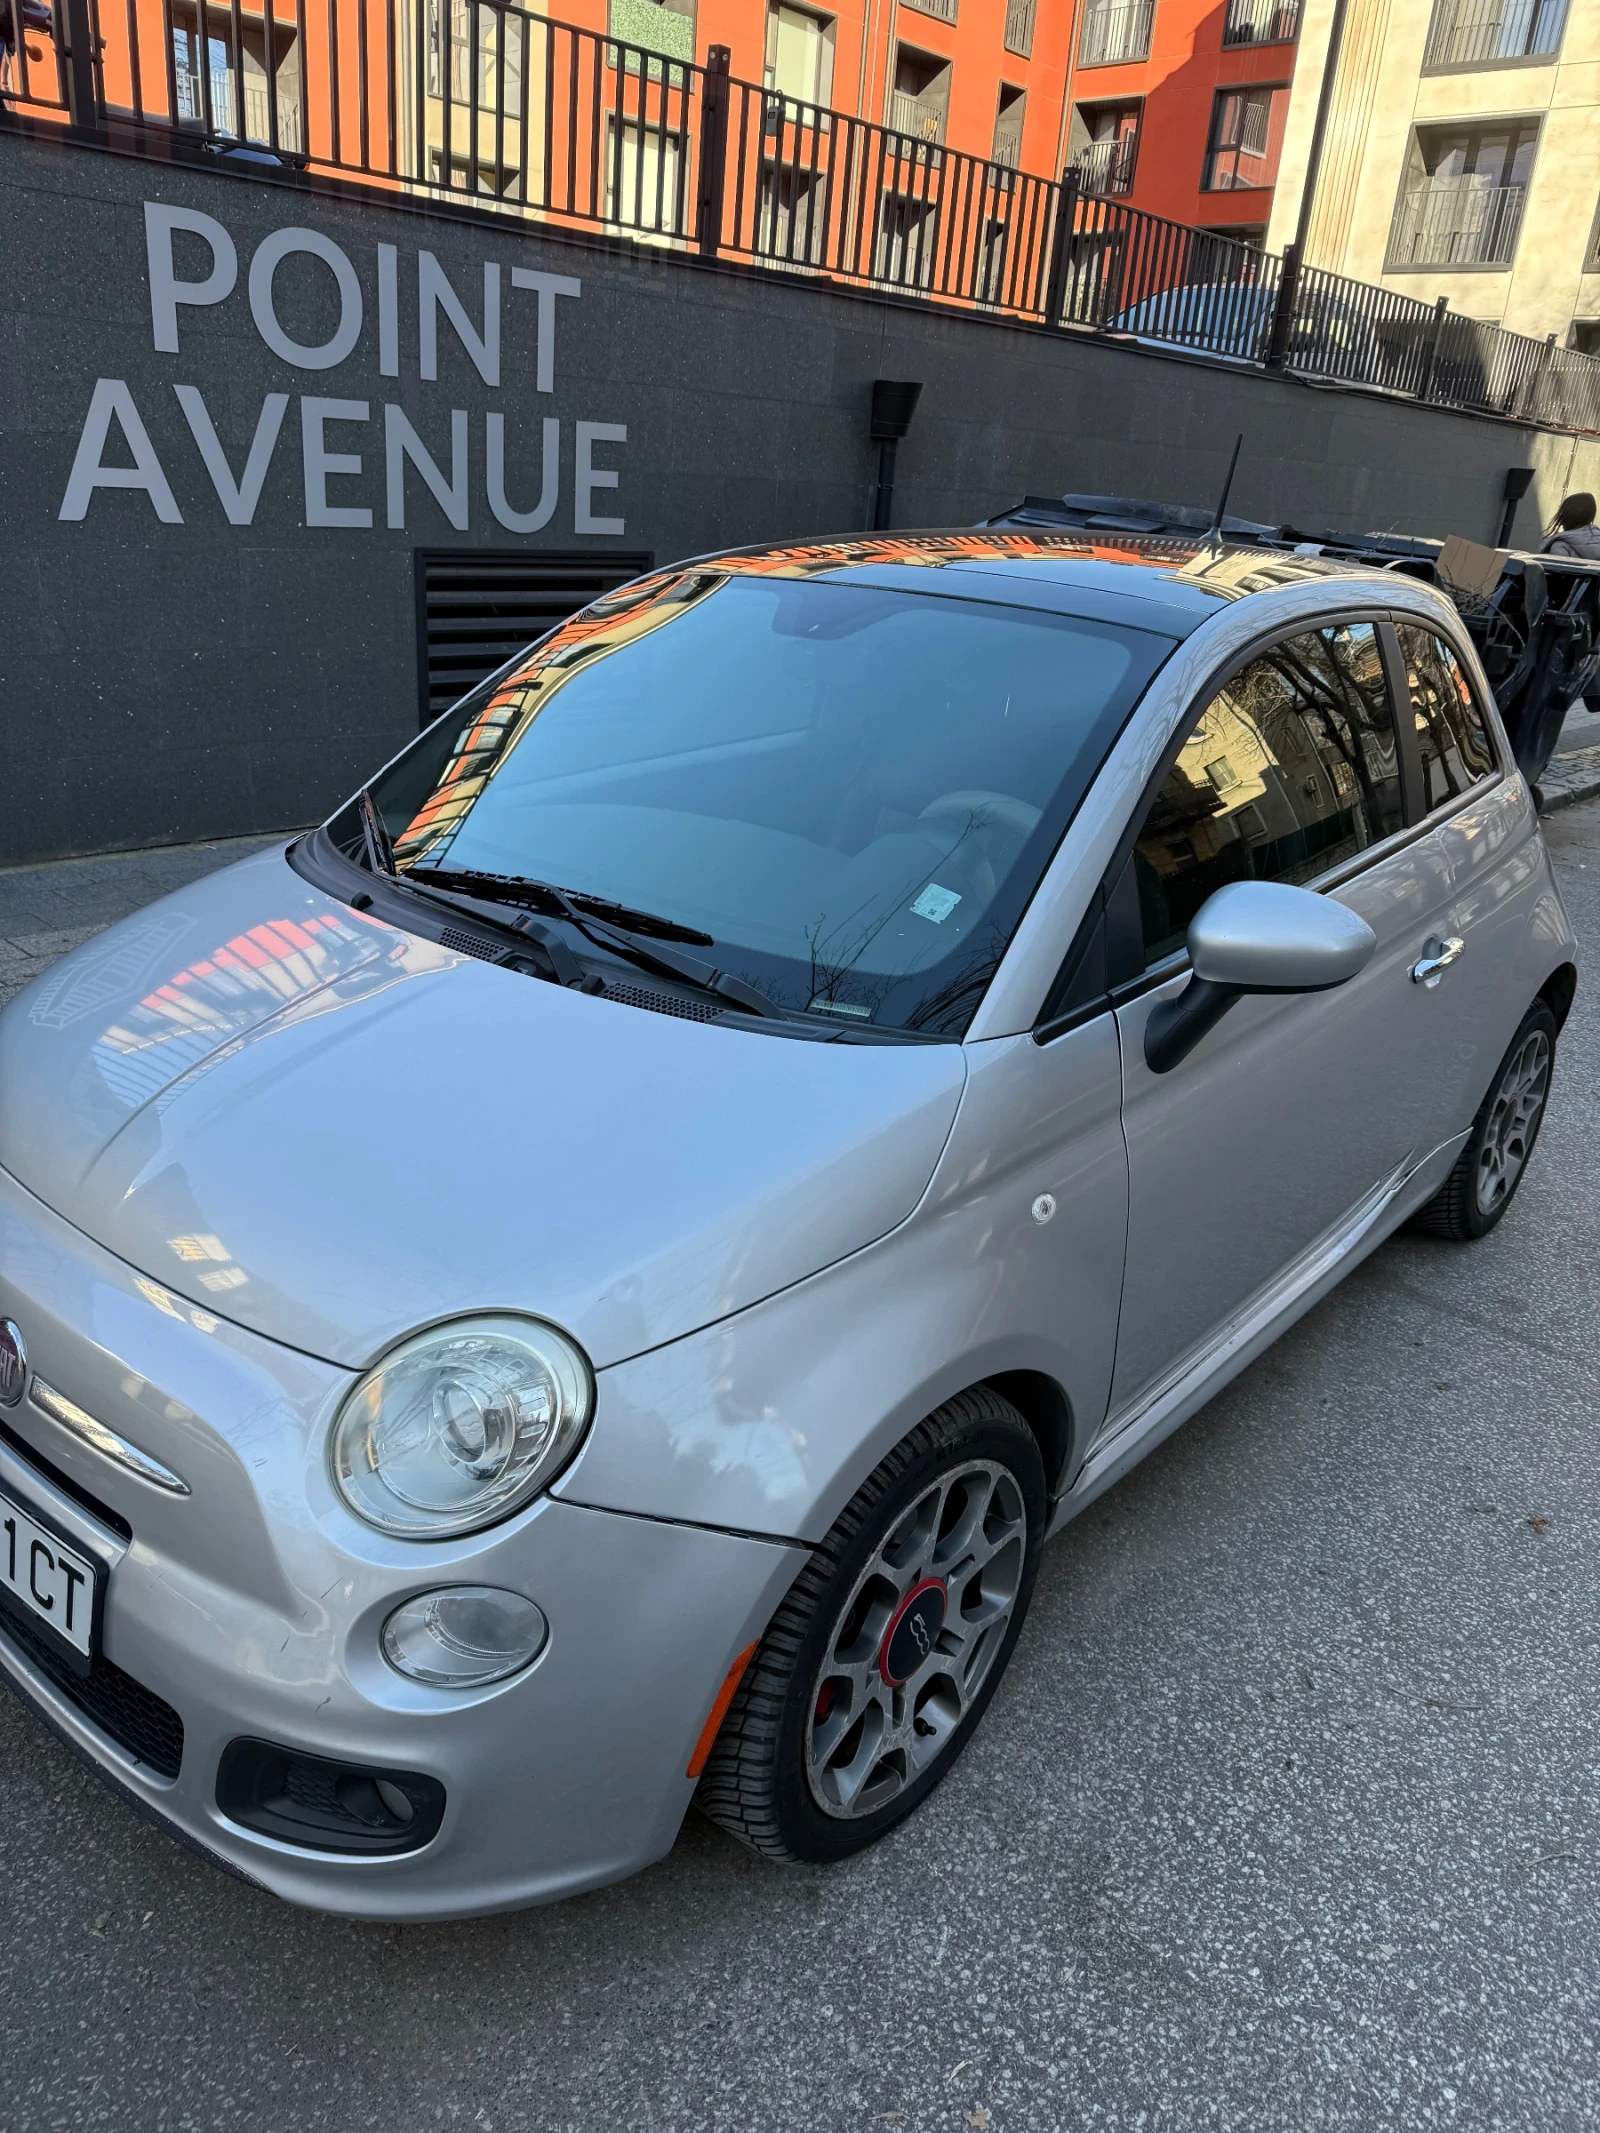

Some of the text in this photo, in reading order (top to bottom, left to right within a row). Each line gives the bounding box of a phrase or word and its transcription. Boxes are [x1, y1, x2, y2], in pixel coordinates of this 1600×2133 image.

[144, 201, 581, 393] POINT
[58, 378, 627, 535] AVENUE
[0, 1345, 16, 1388] AT
[910, 1612, 930, 1655] 500
